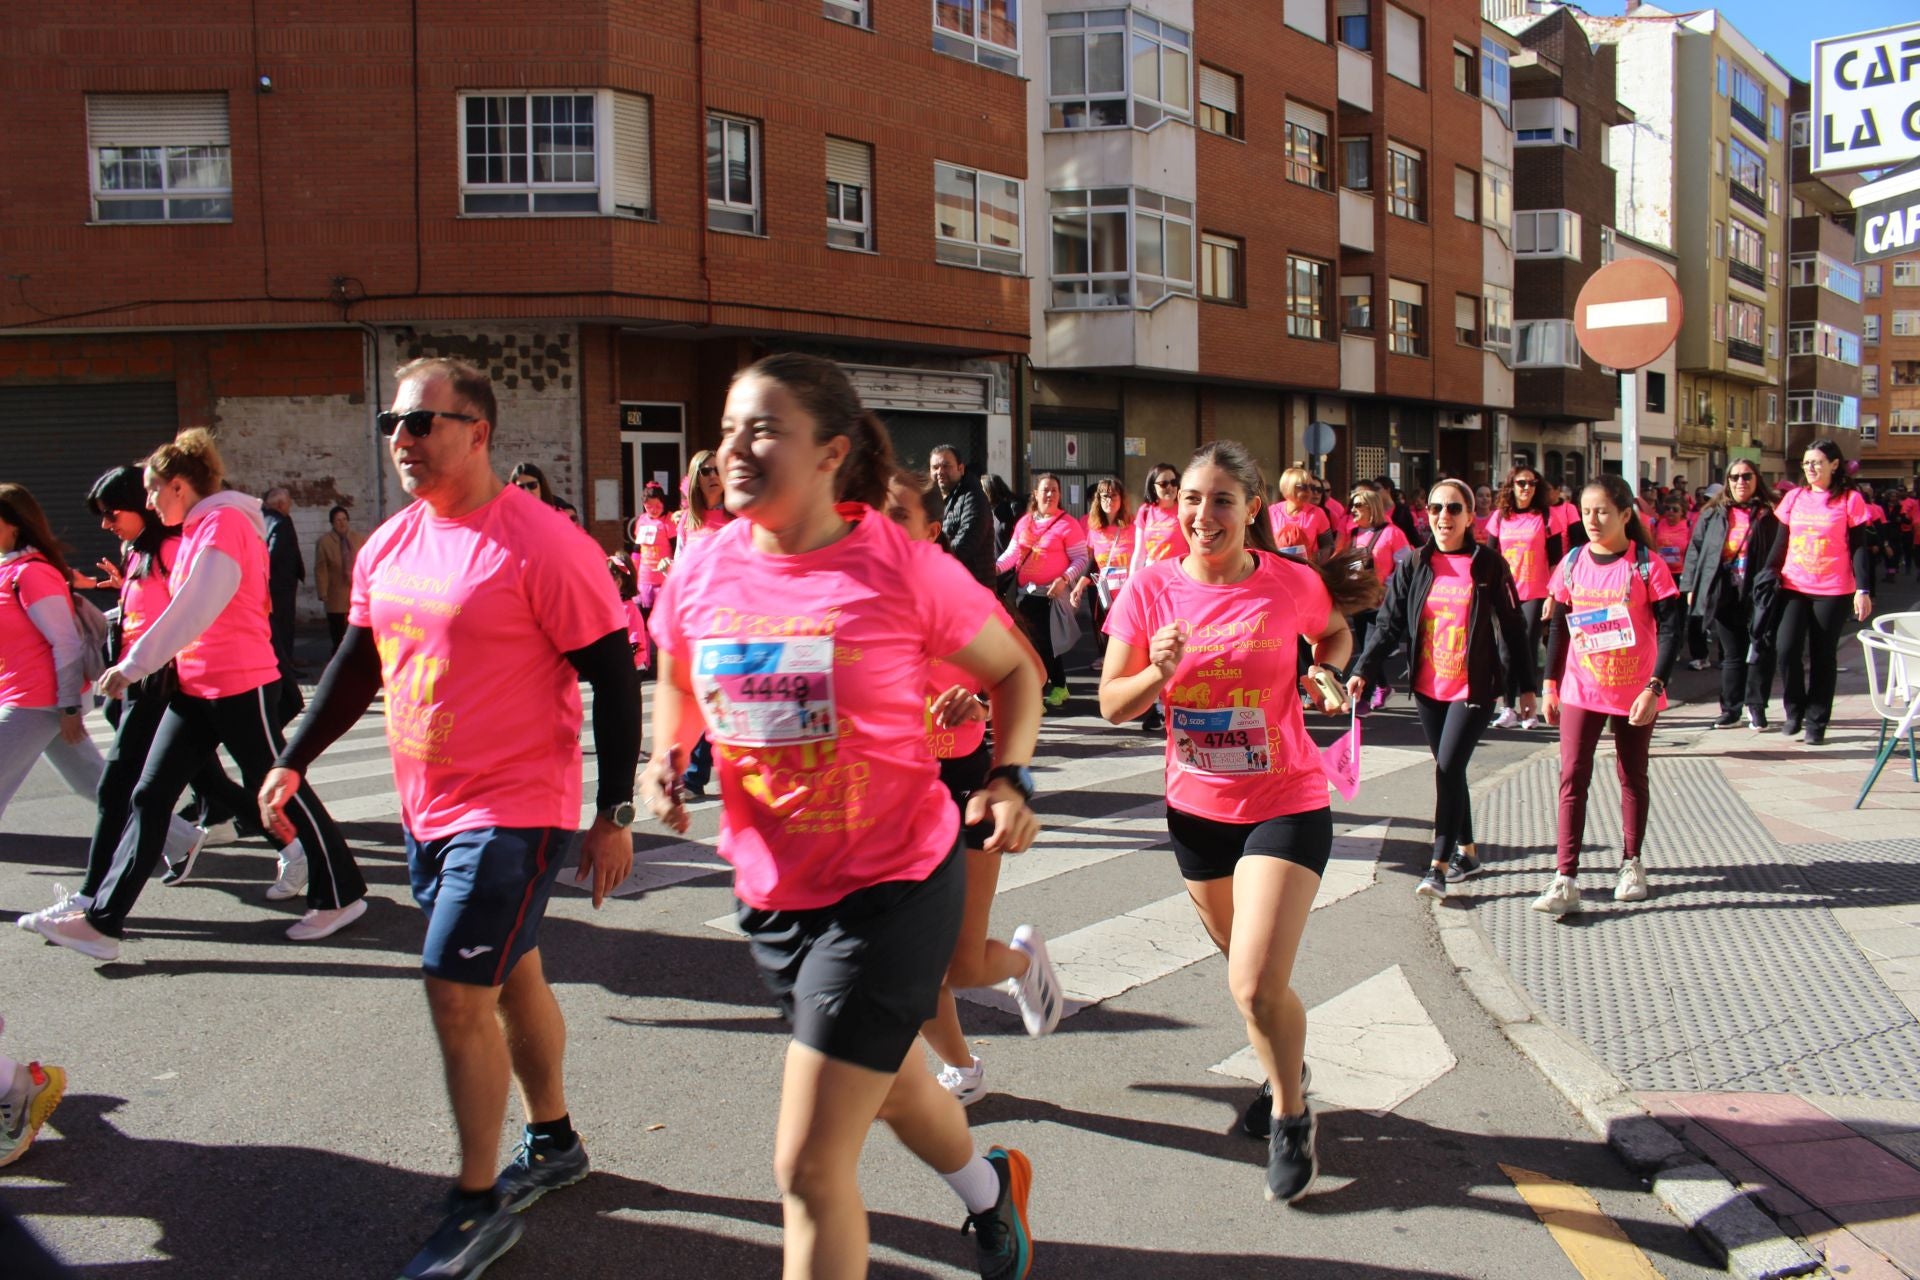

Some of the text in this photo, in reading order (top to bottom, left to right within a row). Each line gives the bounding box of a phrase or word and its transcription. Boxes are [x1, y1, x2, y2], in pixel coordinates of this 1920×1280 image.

[1823, 108, 1881, 154] LA
[627, 411, 642, 425] 20
[1174, 611, 1271, 638] Drasanvi
[1592, 620, 1621, 634] 5975
[1197, 668, 1242, 678] SUZUKI
[1204, 731, 1248, 747] 4743
[1199, 752, 1212, 769] 11
